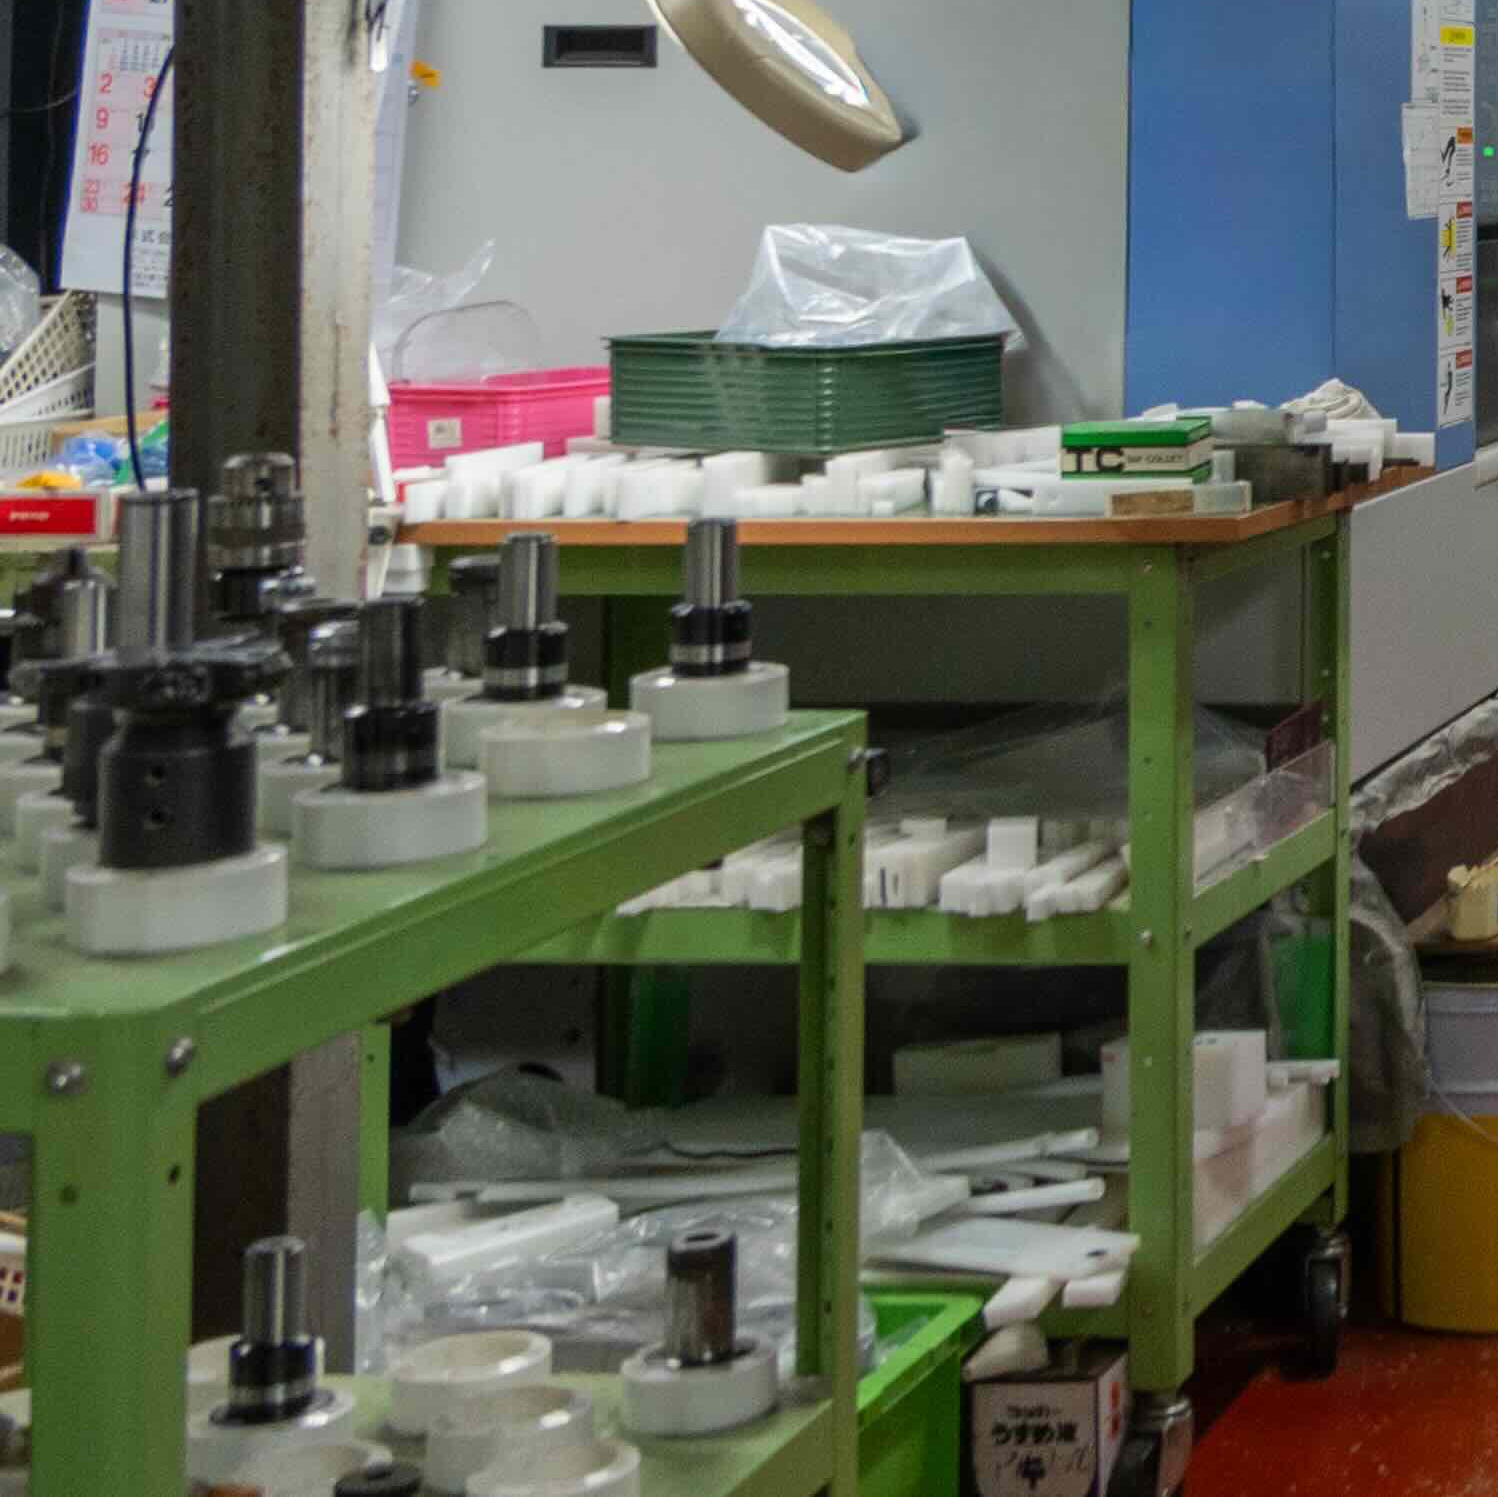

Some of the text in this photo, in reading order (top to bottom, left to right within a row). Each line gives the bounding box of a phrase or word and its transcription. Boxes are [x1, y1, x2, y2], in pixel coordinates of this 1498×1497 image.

[99, 73, 113, 94] 2
[95, 107, 109, 129] 9
[89, 143, 109, 166] 16
[1066, 448, 1124, 471] TC
